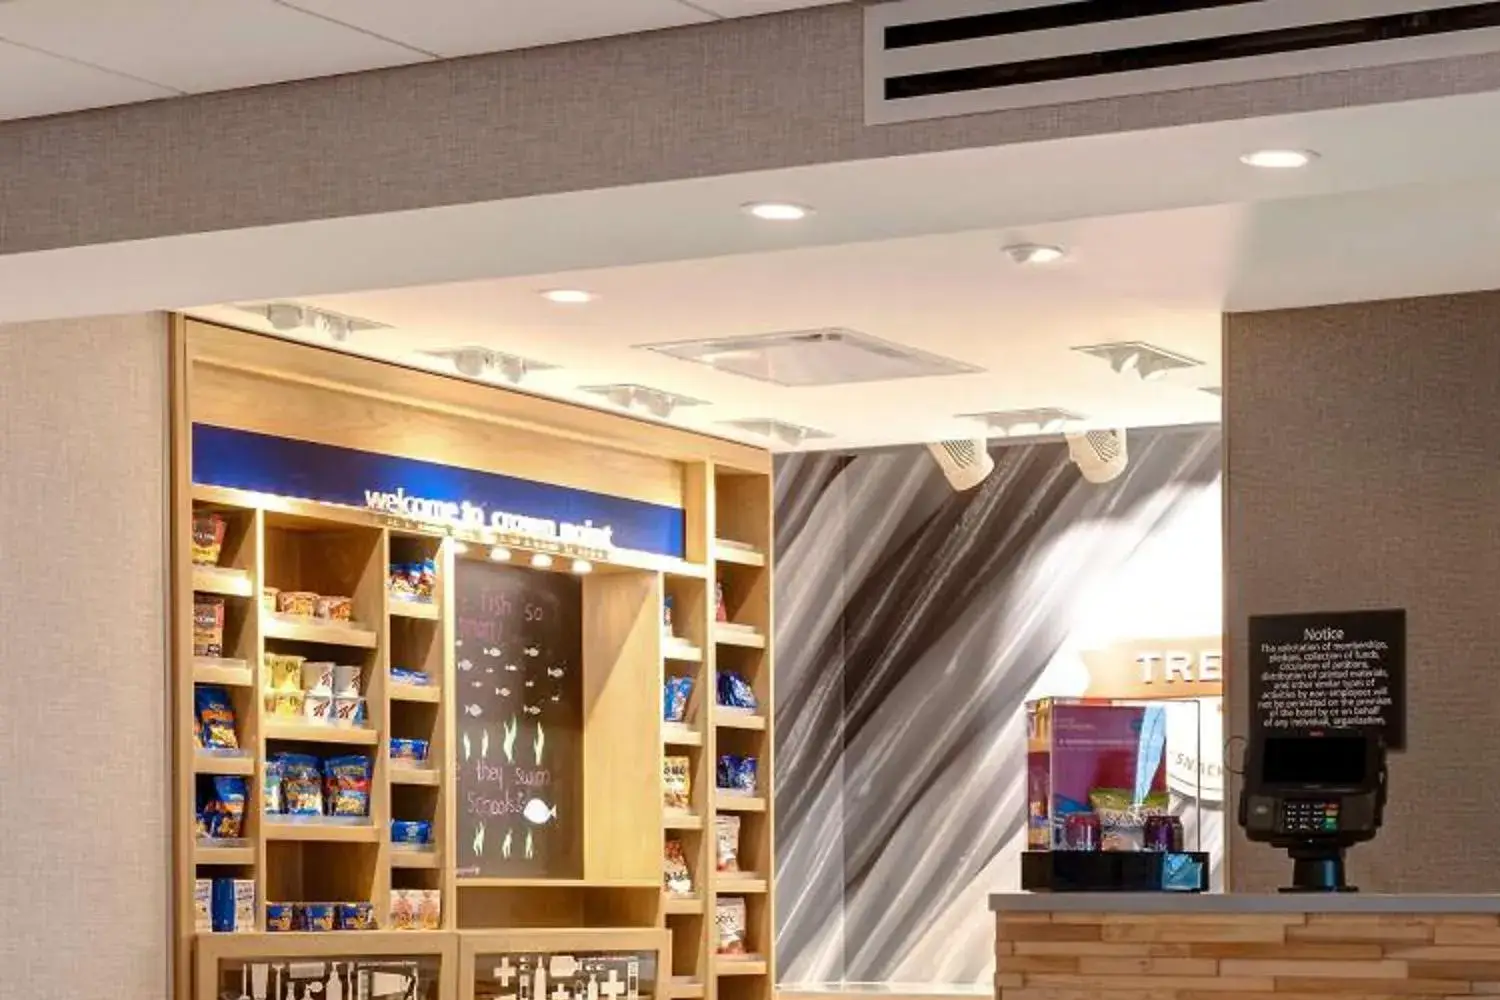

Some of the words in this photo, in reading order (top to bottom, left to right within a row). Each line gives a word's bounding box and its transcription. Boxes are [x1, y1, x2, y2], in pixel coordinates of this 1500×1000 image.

[364, 487, 459, 520] welcome
[460, 500, 484, 526] to
[1303, 627, 1345, 641] Notice
